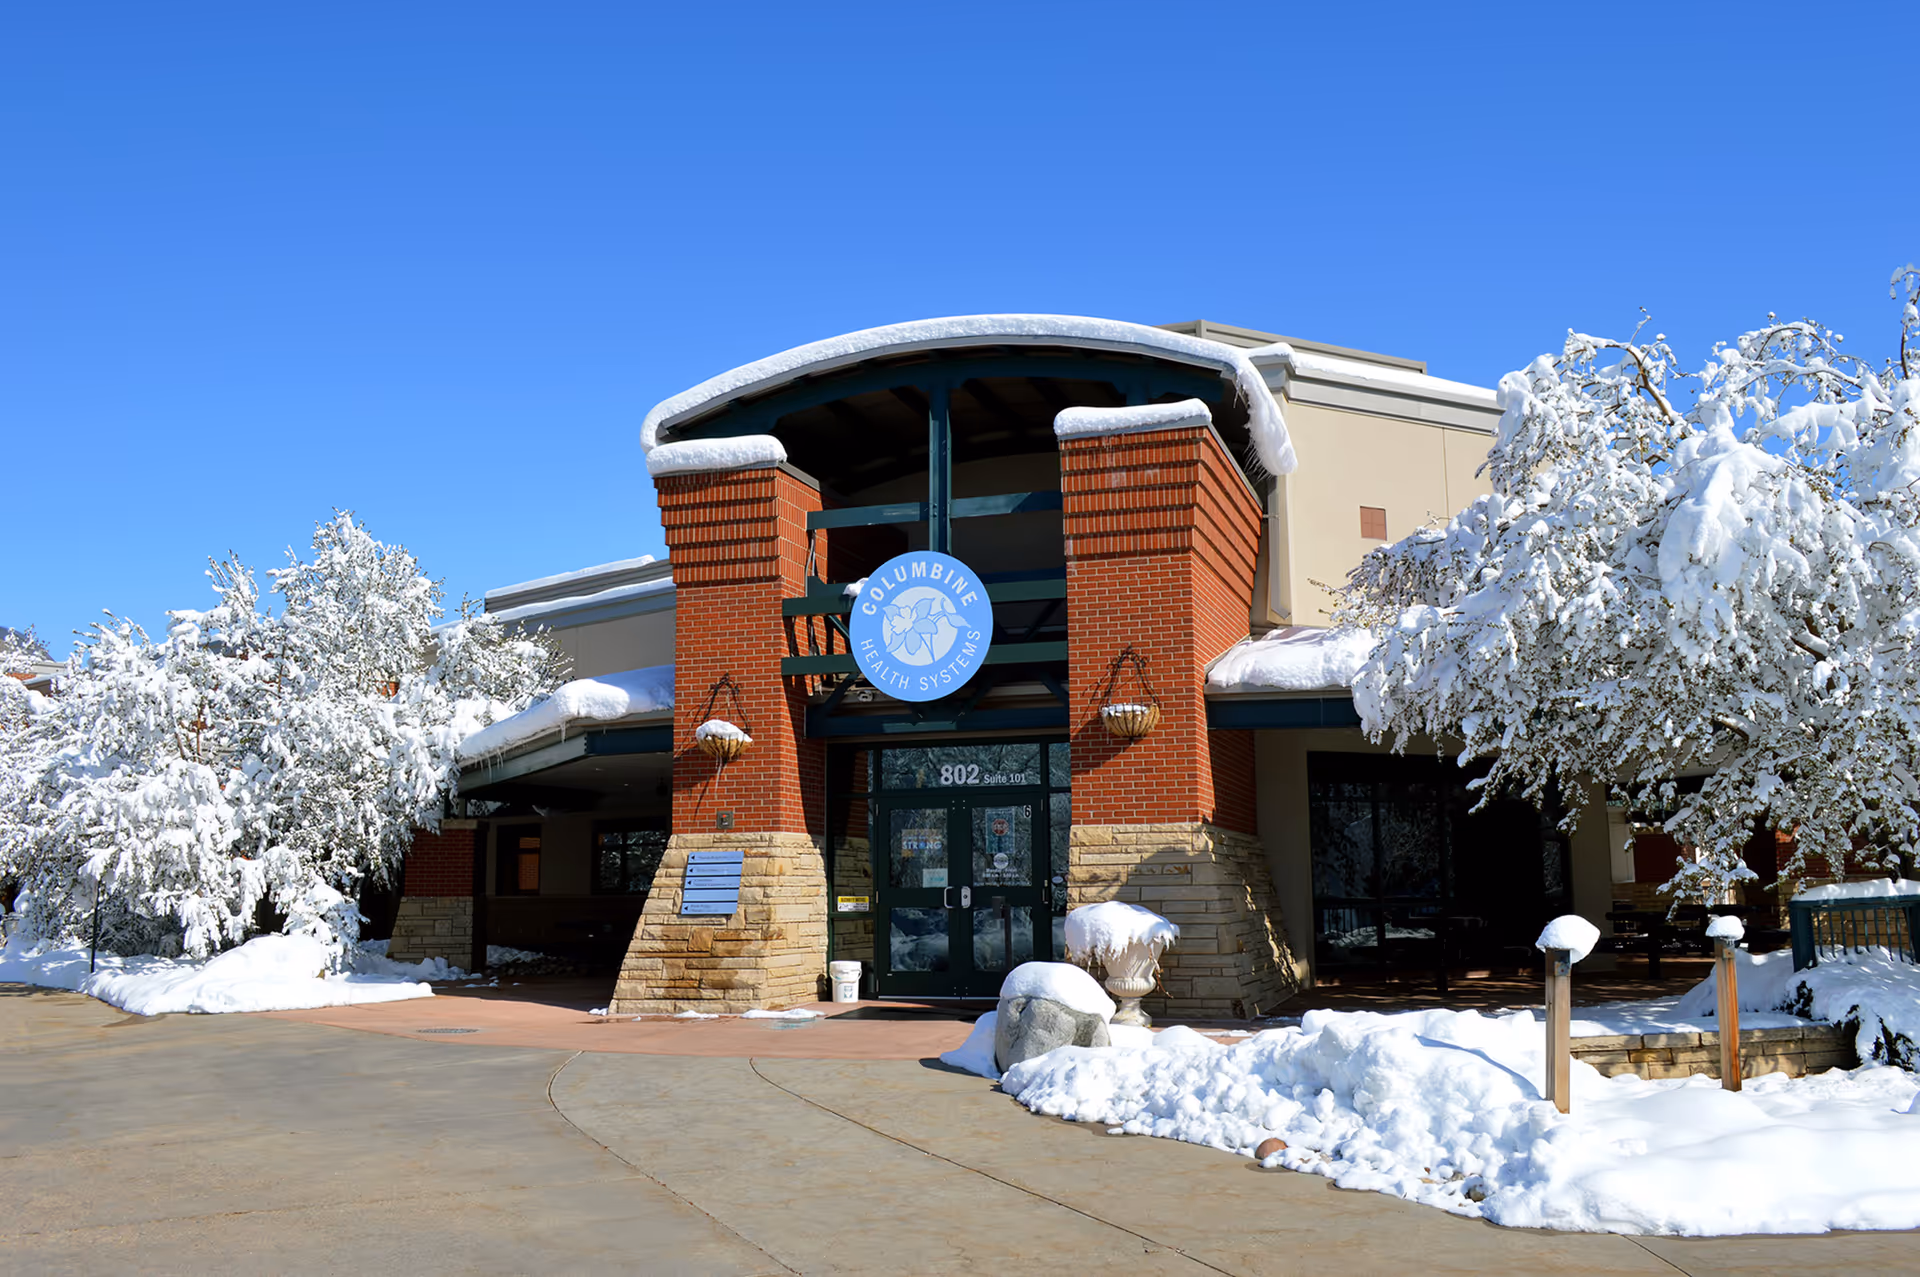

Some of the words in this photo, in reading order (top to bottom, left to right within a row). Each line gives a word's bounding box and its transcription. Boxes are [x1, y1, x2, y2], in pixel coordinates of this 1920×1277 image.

[862, 561, 978, 615] COLUMBINE
[861, 638, 910, 690] HEALTH
[919, 630, 981, 691] SYSTEMS
[940, 763, 980, 785] 802
[983, 773, 1007, 784] Suite
[1009, 773, 1026, 783] 101
[1023, 805, 1032, 818] 6
